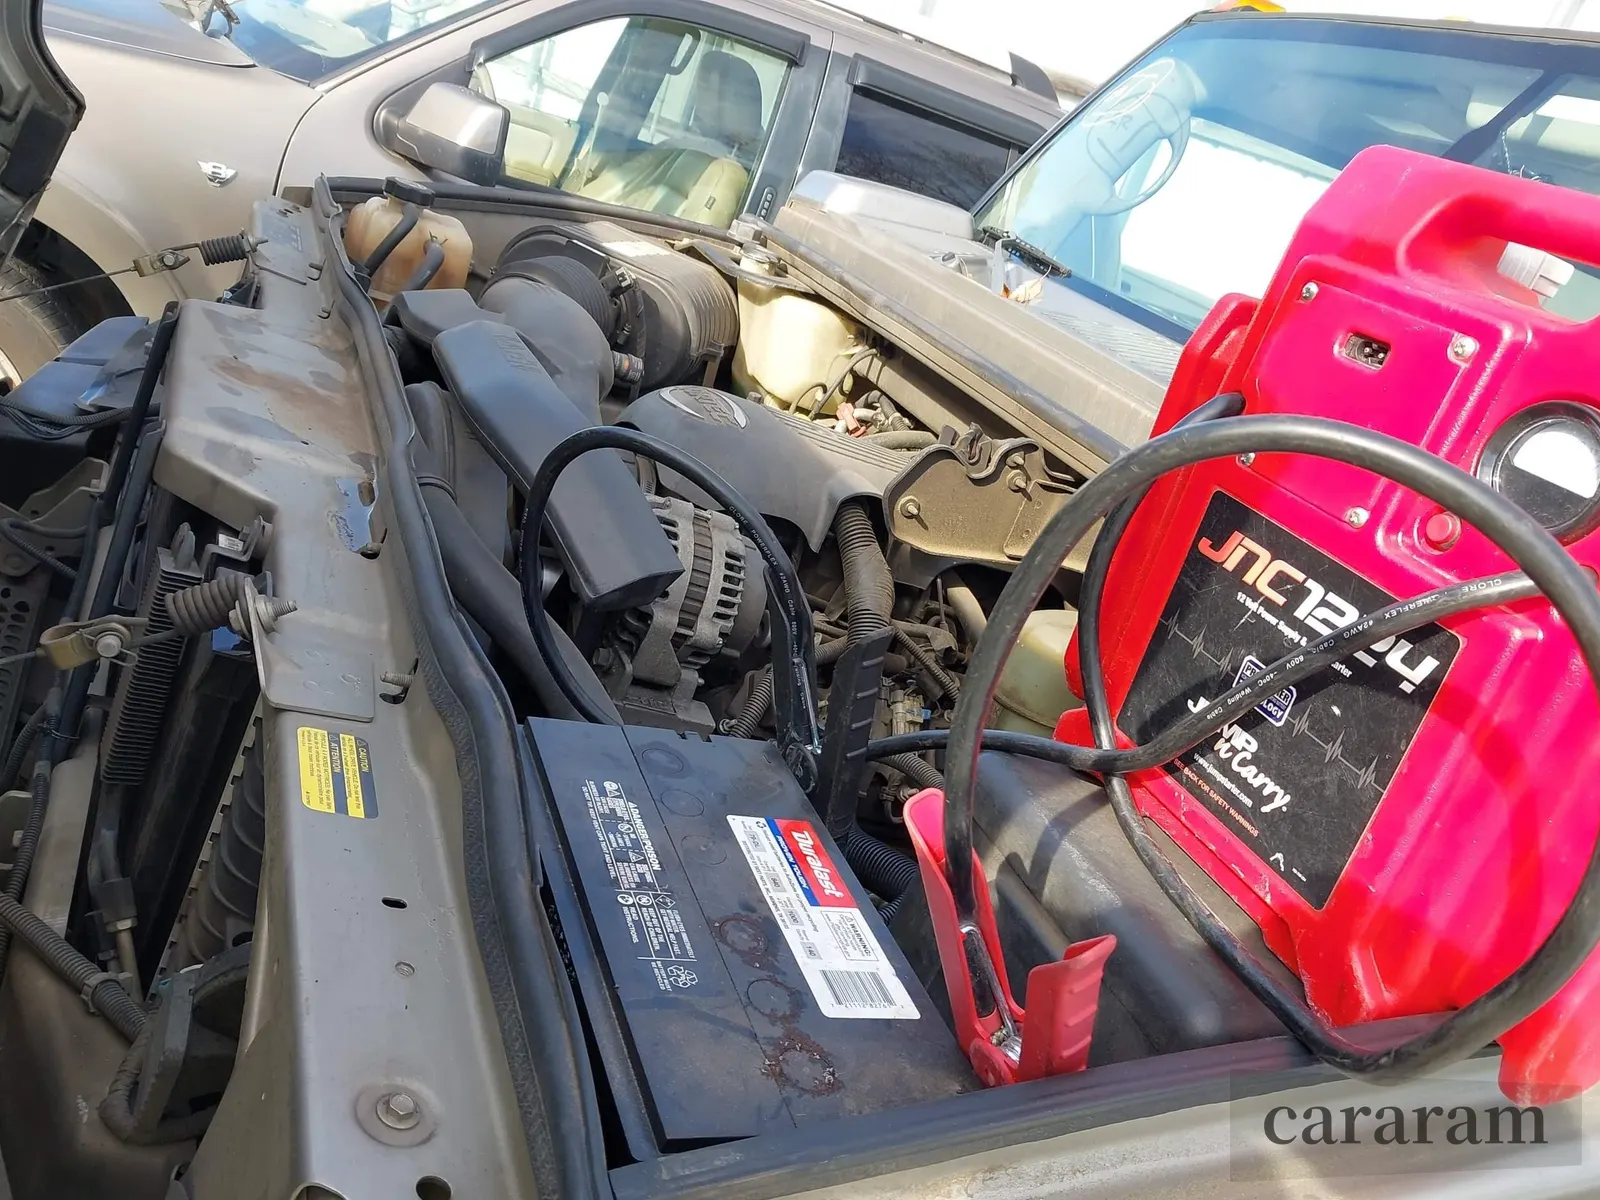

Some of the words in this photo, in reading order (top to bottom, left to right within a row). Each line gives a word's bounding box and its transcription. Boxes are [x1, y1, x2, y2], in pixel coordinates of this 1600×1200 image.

[728, 506, 748, 525] CLORE
[750, 529, 778, 566] POWERFLEX
[788, 600, 796, 616] Cable
[1461, 578, 1502, 593] CLORE
[1236, 592, 1246, 604] 12
[1245, 596, 1259, 612] Volt
[1257, 606, 1279, 626] Power
[1278, 620, 1302, 642] Supply
[1300, 636, 1308, 647] &
[1343, 620, 1374, 638] #2AWG
[1286, 655, 1304, 670] 600V
[1228, 686, 1252, 705] Welding
[1206, 706, 1222, 720] Cable
[330, 741, 341, 772] ATTENTION
[358, 747, 369, 772] CAUTION
[1193, 752, 1253, 808] www.jumpstarter.com
[1231, 751, 1291, 812] Carry
[1174, 758, 1184, 771] SEE
[1183, 767, 1198, 784] BACK
[1198, 778, 1210, 795] FOR
[1209, 789, 1230, 812] SAFETY
[1229, 807, 1259, 837] WARNINGS
[603, 853, 612, 863] AND
[775, 835, 795, 863] PROVEN
[790, 863, 809, 889] TOUGH
[791, 830, 844, 898] Duralast
[628, 906, 639, 920] READ
[640, 907, 651, 921] REACH
[647, 907, 656, 918] KEEP
[651, 918, 659, 926] OUT
[769, 877, 780, 887] 840
[787, 910, 799, 923] 1000
[805, 946, 816, 956] 140
[656, 934, 665, 942] THE
[848, 923, 873, 956] WARNING:
[652, 968, 666, 990] RECYCLED
[655, 960, 667, 978] BATTERY
[662, 979, 672, 991] MUST
